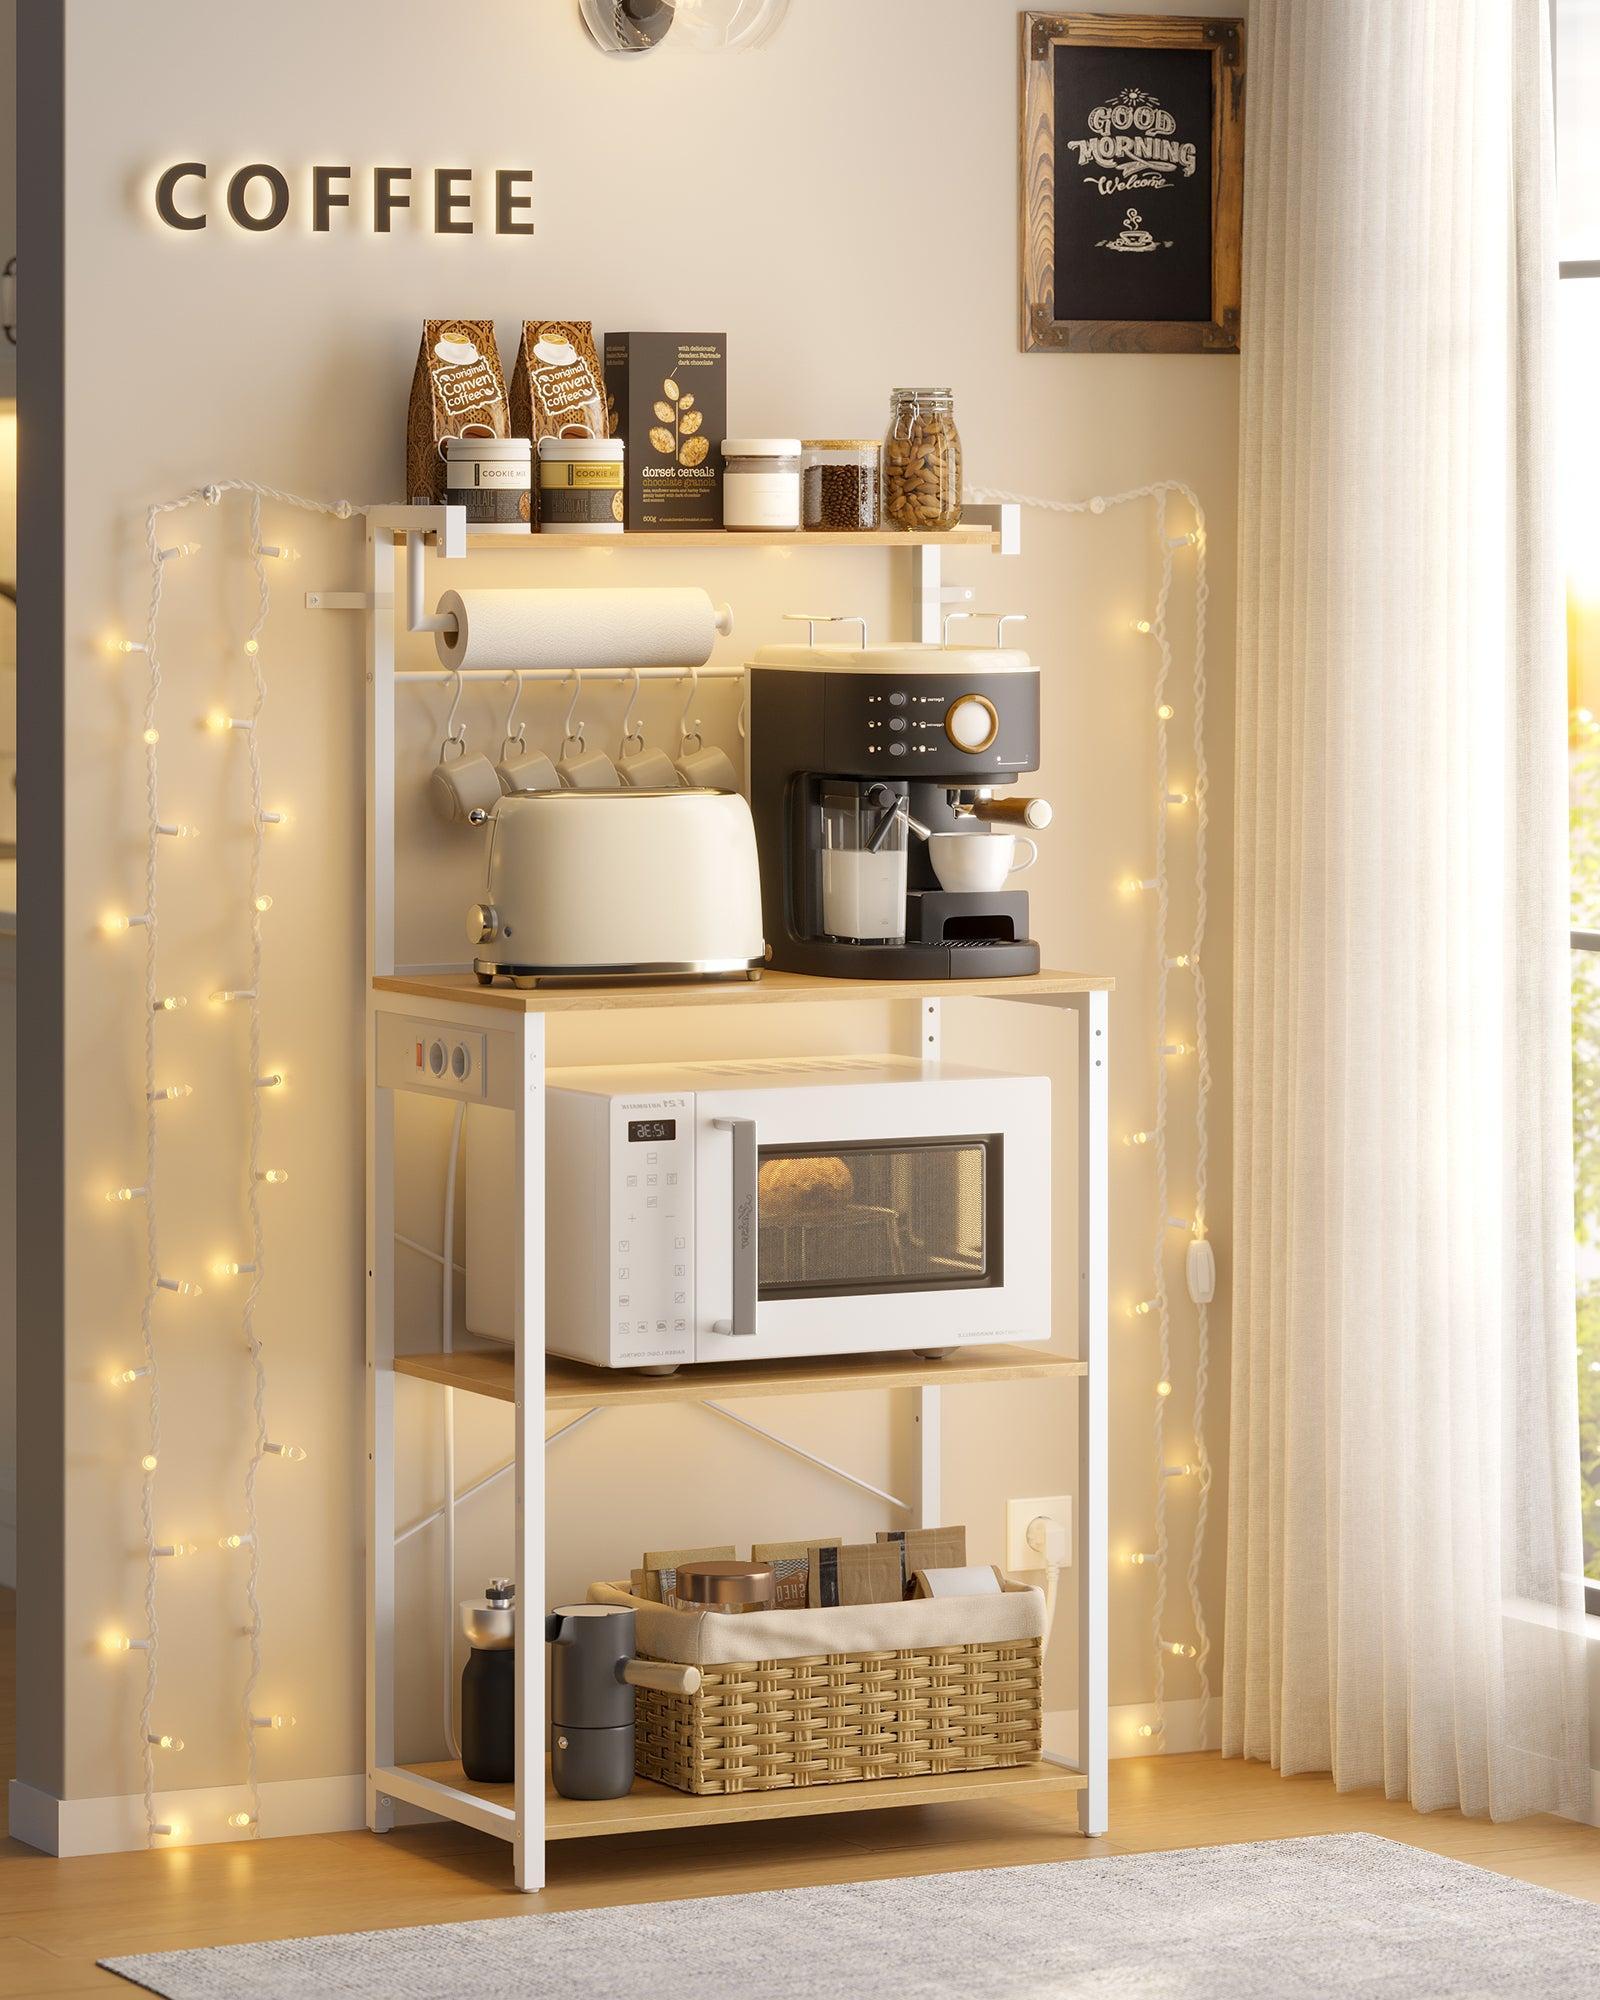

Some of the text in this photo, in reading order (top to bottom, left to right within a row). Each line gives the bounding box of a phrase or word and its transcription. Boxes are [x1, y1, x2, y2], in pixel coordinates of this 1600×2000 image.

[1087, 105, 1176, 137] GOOD
[1067, 135, 1196, 177] MORNING
[1083, 171, 1174, 195] Welcome
[155, 162, 534, 234] COFFEE
[455, 362, 487, 380] original
[554, 362, 585, 380] original
[443, 374, 492, 396] Conven
[542, 374, 591, 396] Conven
[448, 390, 481, 407] coffee
[547, 391, 581, 407] coffee
[482, 470, 515, 478] COOKIE
[575, 470, 608, 478] COOKIE
[642, 466, 715, 477] dorset cereals
[642, 478, 716, 489] chocolate granola
